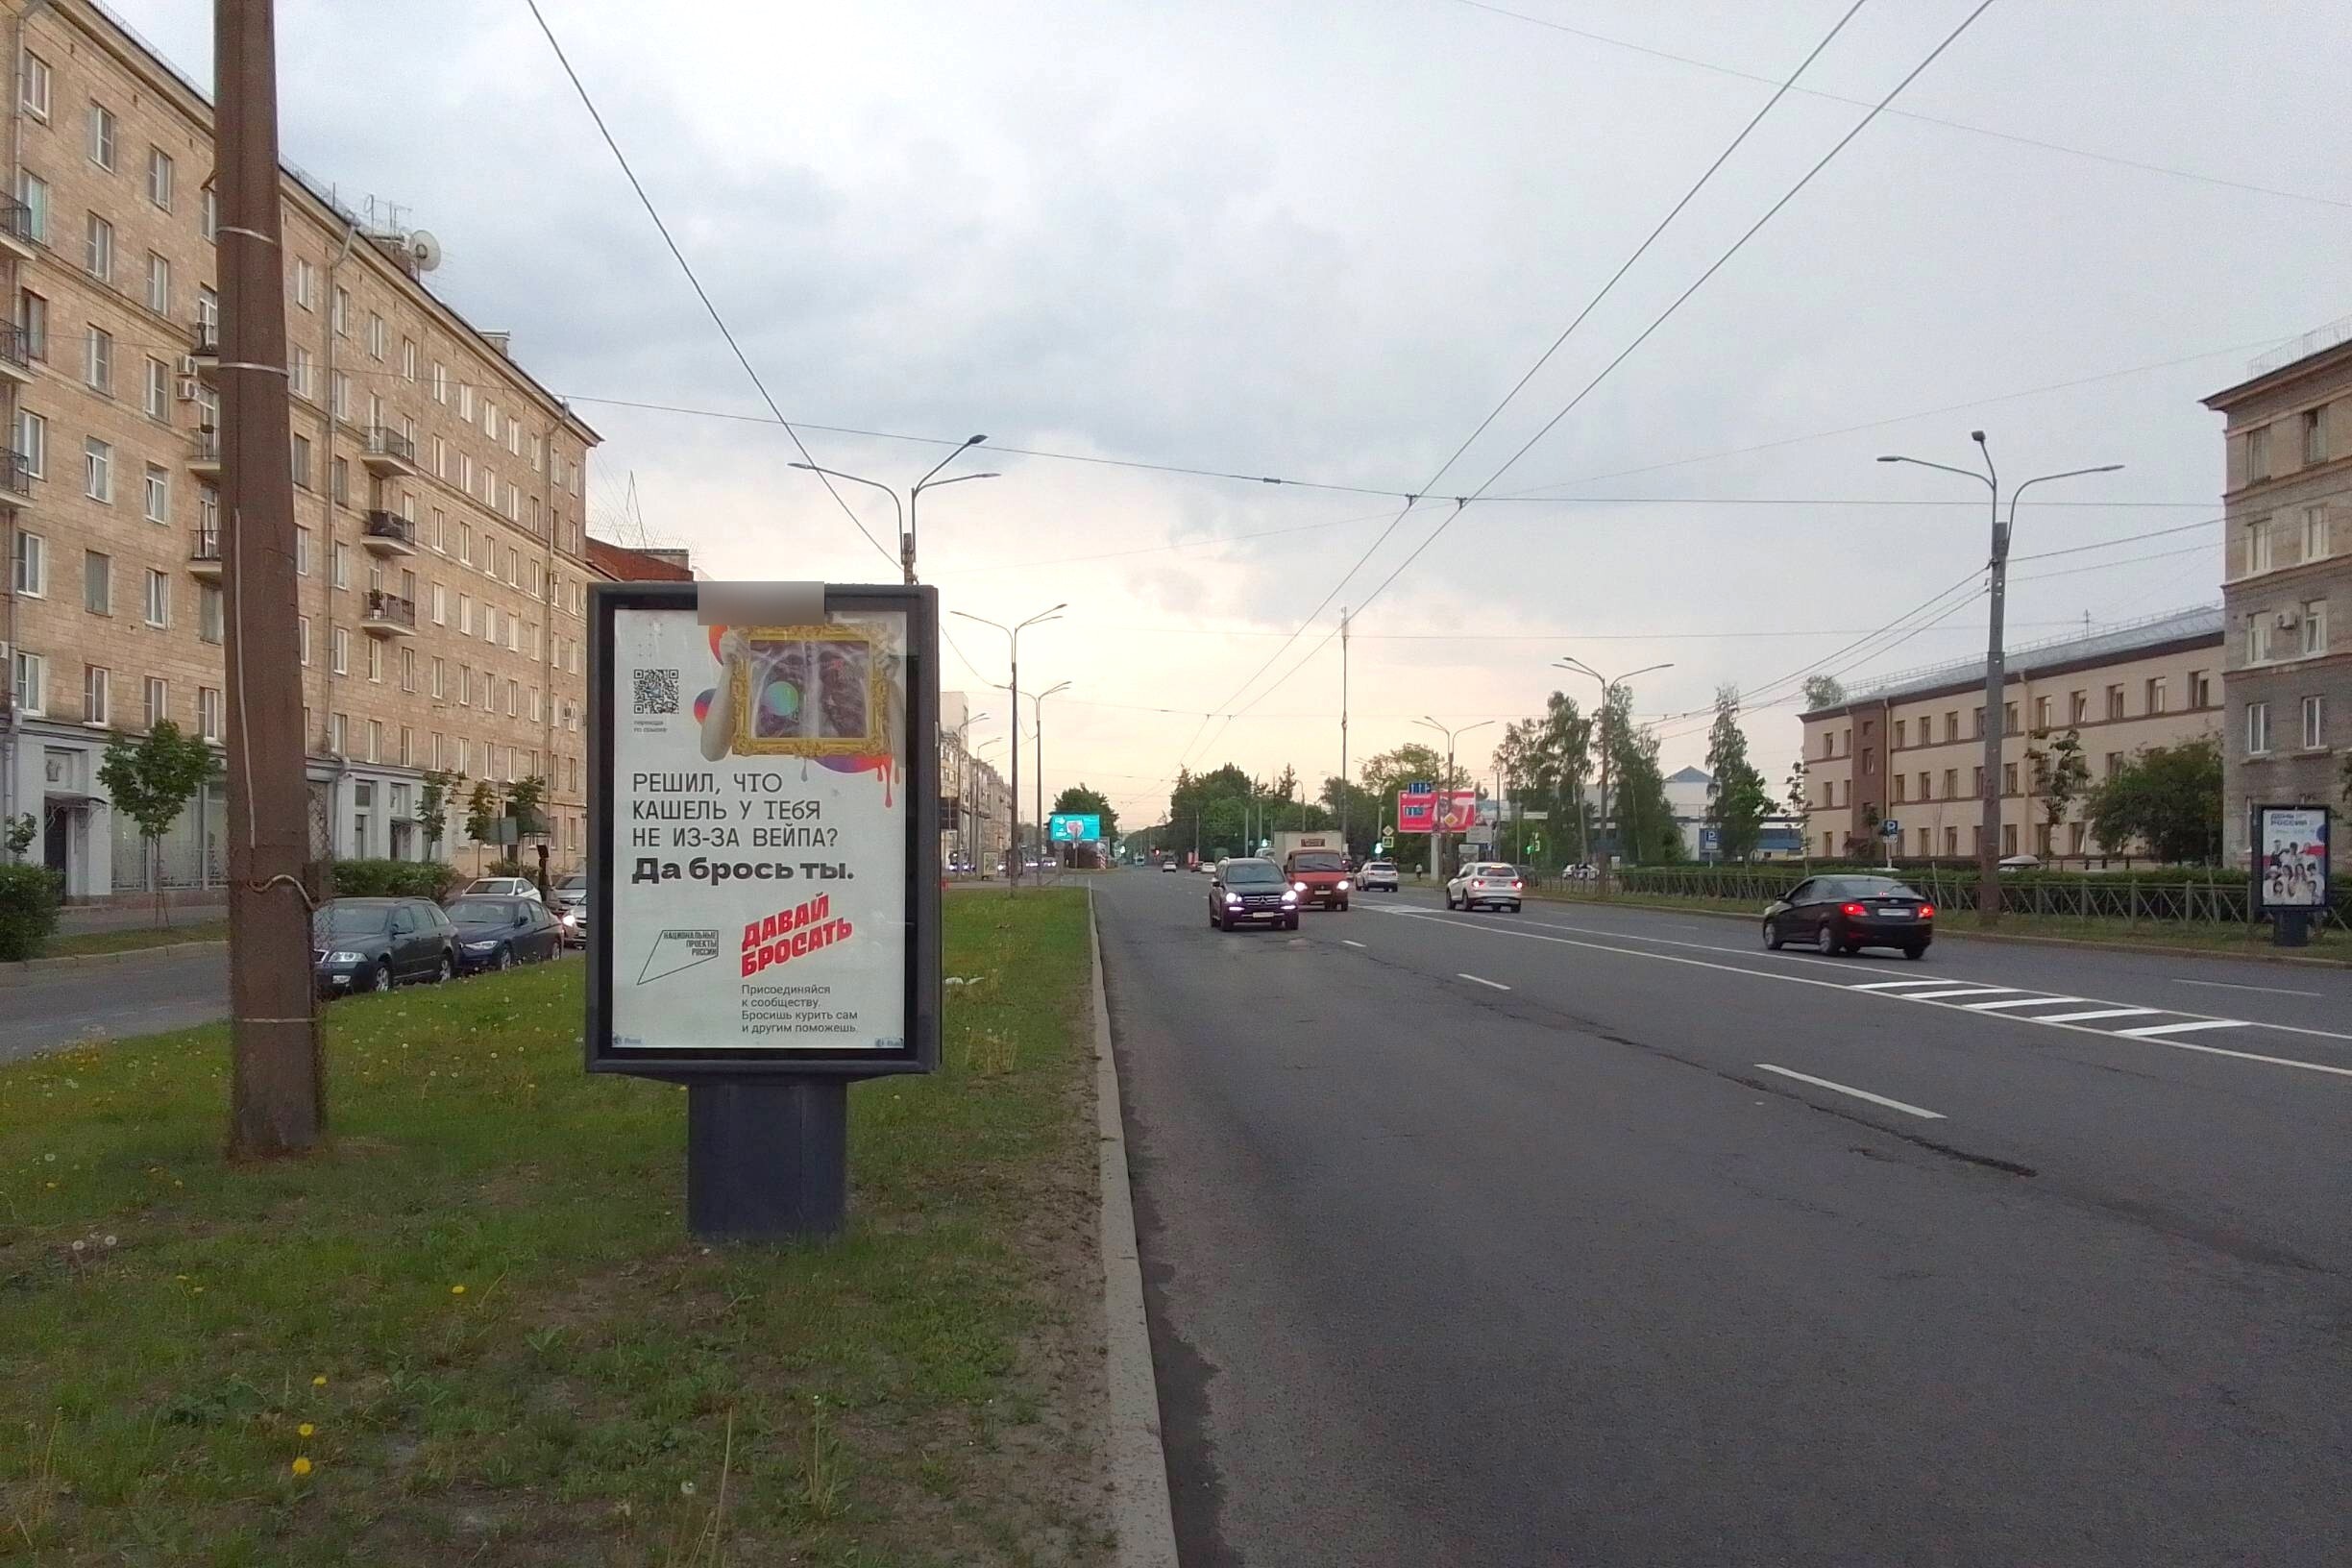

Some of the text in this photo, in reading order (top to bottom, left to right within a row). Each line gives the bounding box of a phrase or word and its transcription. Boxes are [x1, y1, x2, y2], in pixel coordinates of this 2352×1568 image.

[632, 772, 783, 795] РЕШИЛ, ЧТО
[632, 799, 727, 820] КАШЕЛЬ
[739, 800, 752, 820] У
[632, 823, 839, 847] НЕ ИЗ-ЗА ВЕЙПА?
[631, 857, 854, 886] Да брось ты.
[742, 892, 829, 952] ДАВАЙ
[686, 940, 717, 948] ПРОЕКТЫ
[741, 917, 853, 978] БРОСАТЬ
[742, 984, 831, 996] Присоединяйся
[750, 997, 821, 1010] сообществу.
[742, 1010, 858, 1022] Бросишь курить сам
[742, 1024, 748, 1033] и
[751, 1024, 793, 1035] другим
